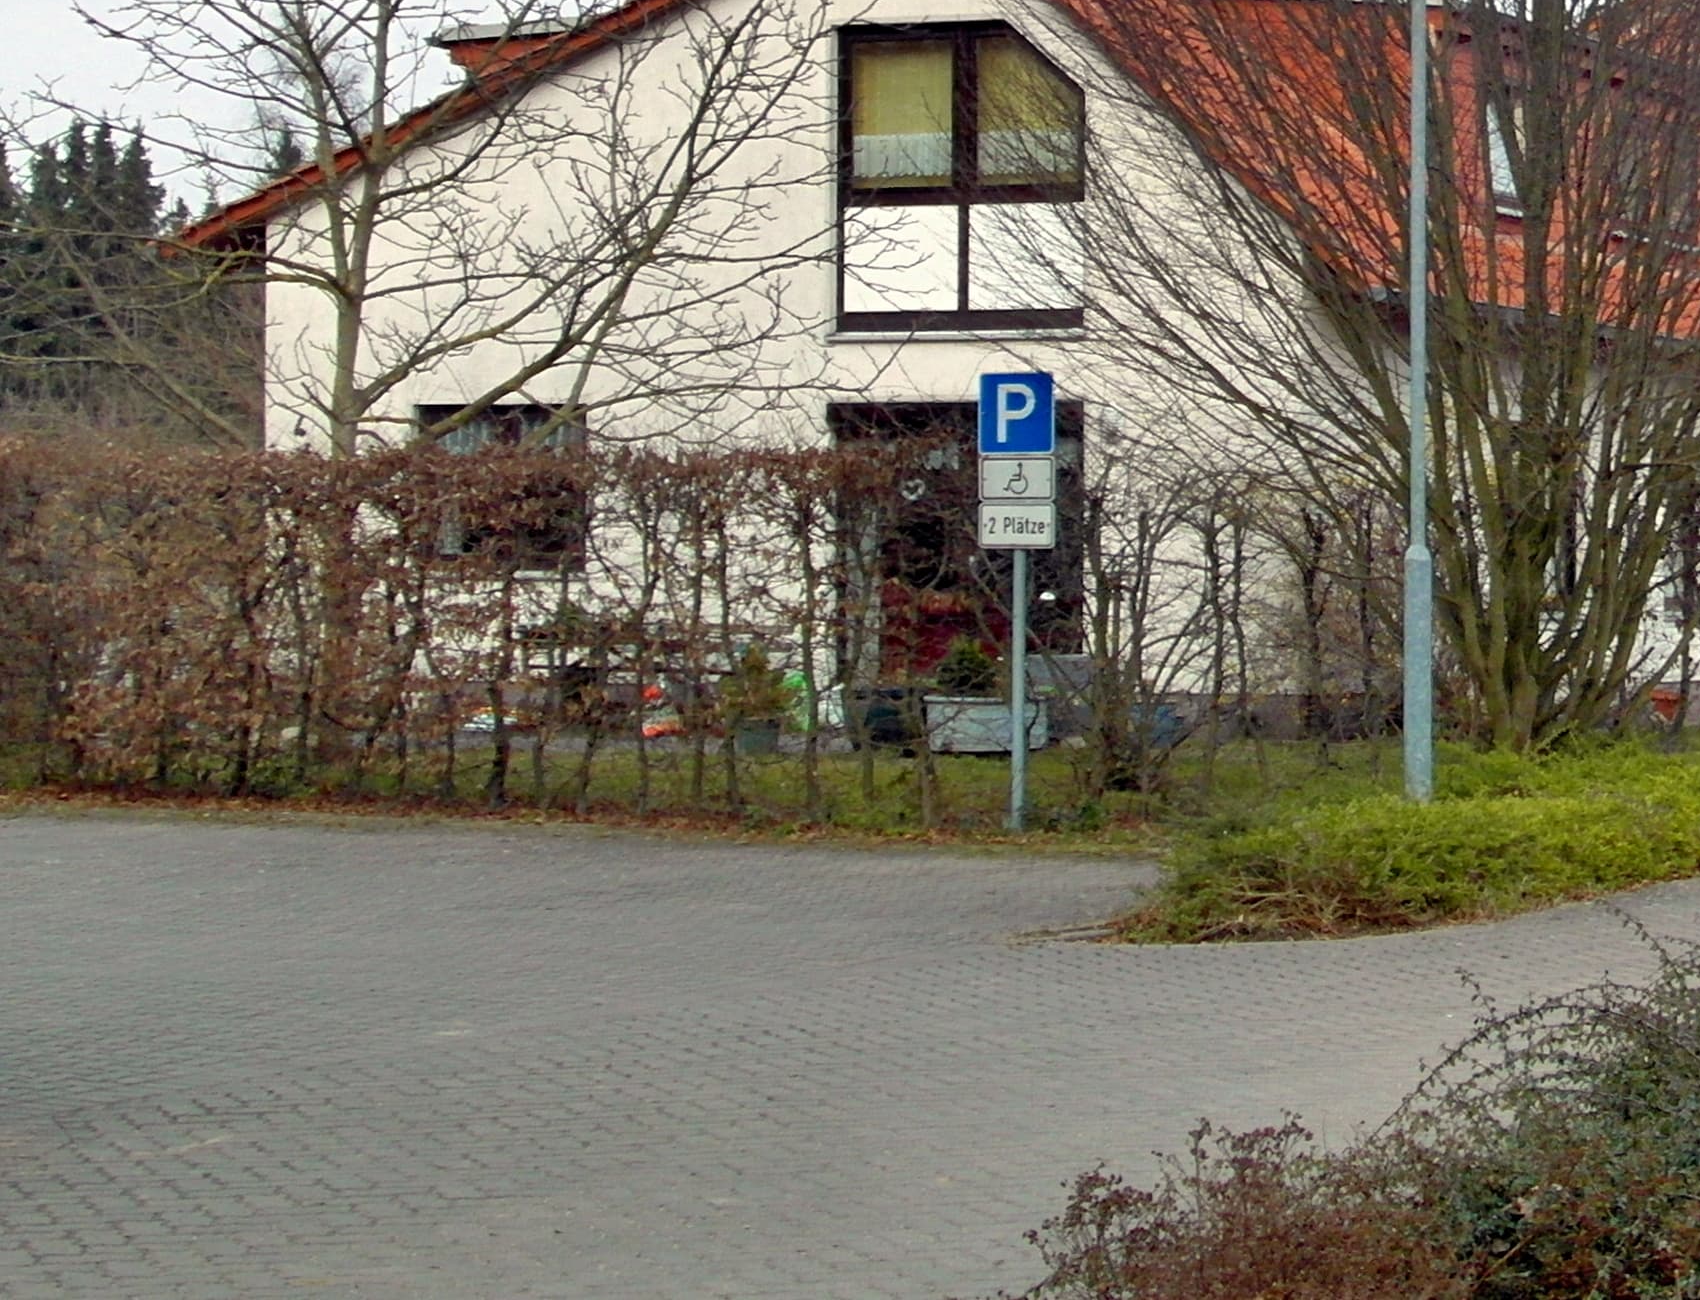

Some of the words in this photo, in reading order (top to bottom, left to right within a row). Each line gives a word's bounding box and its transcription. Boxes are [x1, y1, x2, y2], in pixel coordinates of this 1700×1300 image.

[996, 383, 1035, 443] P
[988, 516, 996, 534] 2
[1003, 516, 1045, 534] Plätze
